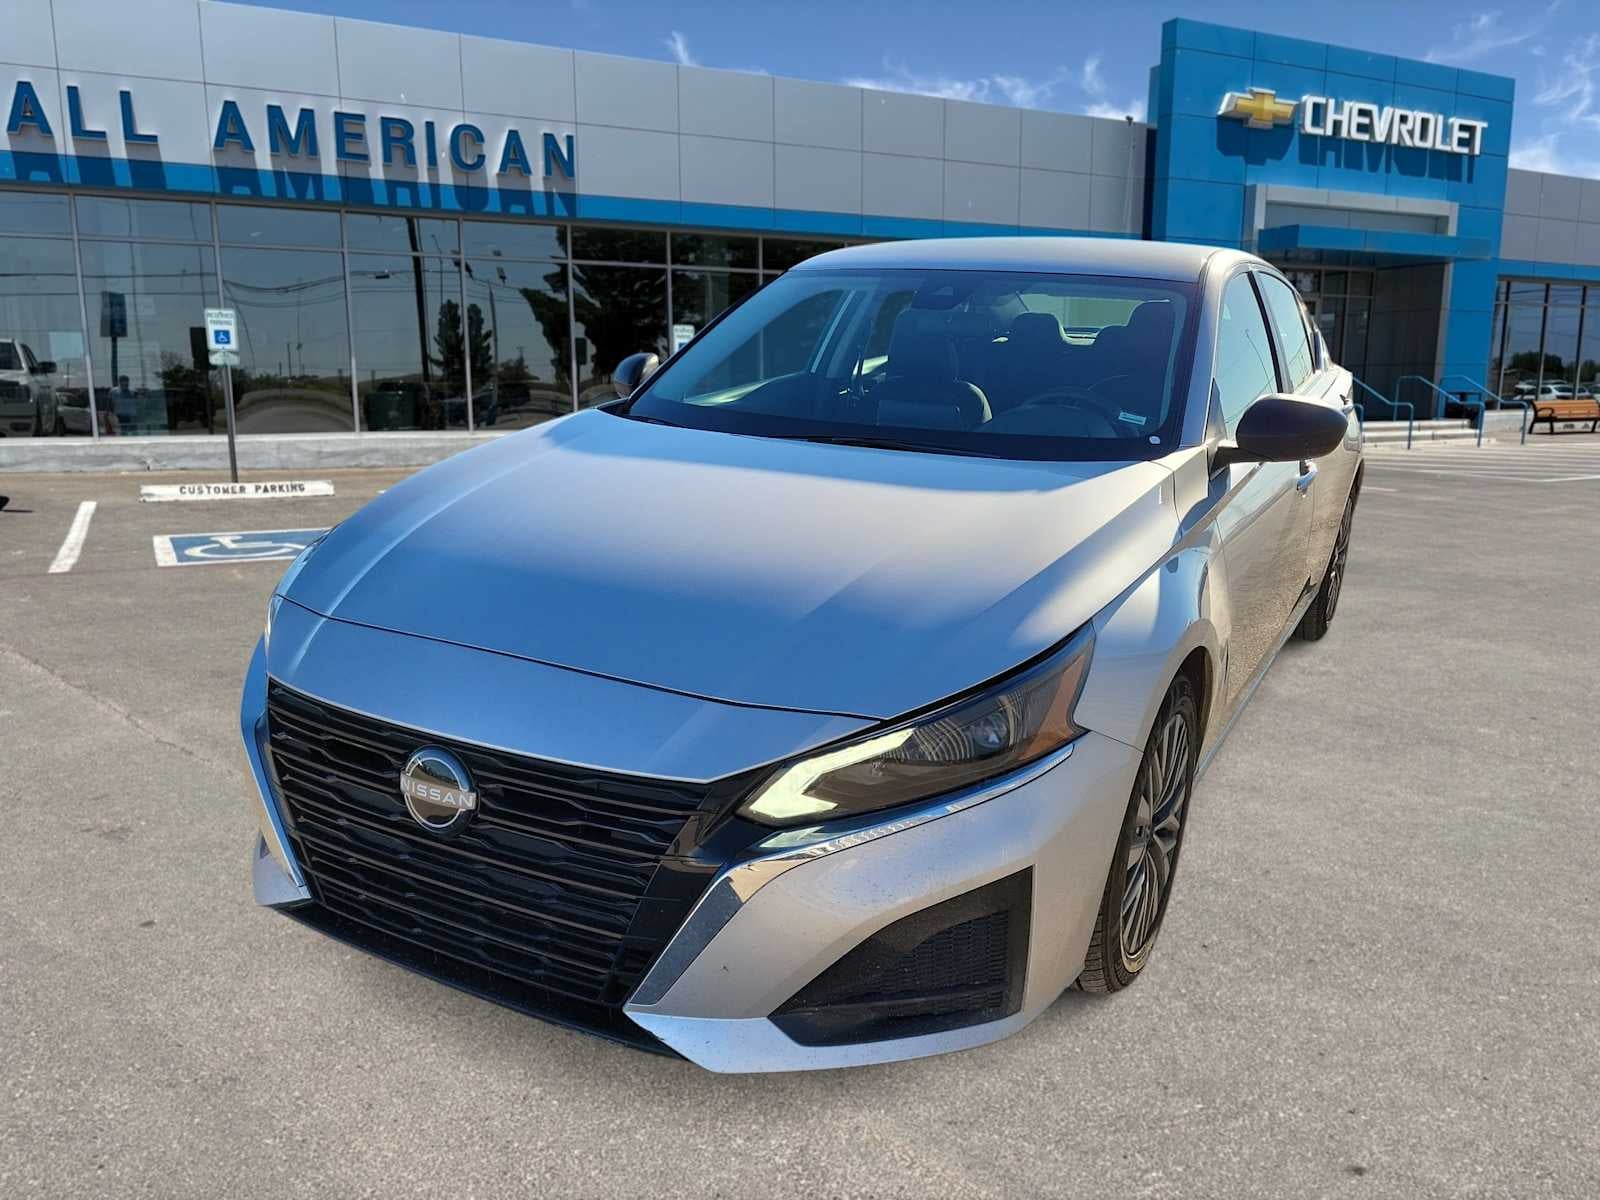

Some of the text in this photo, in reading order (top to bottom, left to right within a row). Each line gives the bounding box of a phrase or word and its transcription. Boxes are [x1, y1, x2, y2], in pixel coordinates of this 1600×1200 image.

[6, 80, 576, 179] ALL AMERICAN
[1301, 94, 1488, 155] CHEVROLET
[178, 483, 307, 495] CUSTOMER PARKING
[401, 775, 474, 808] NISSAN
